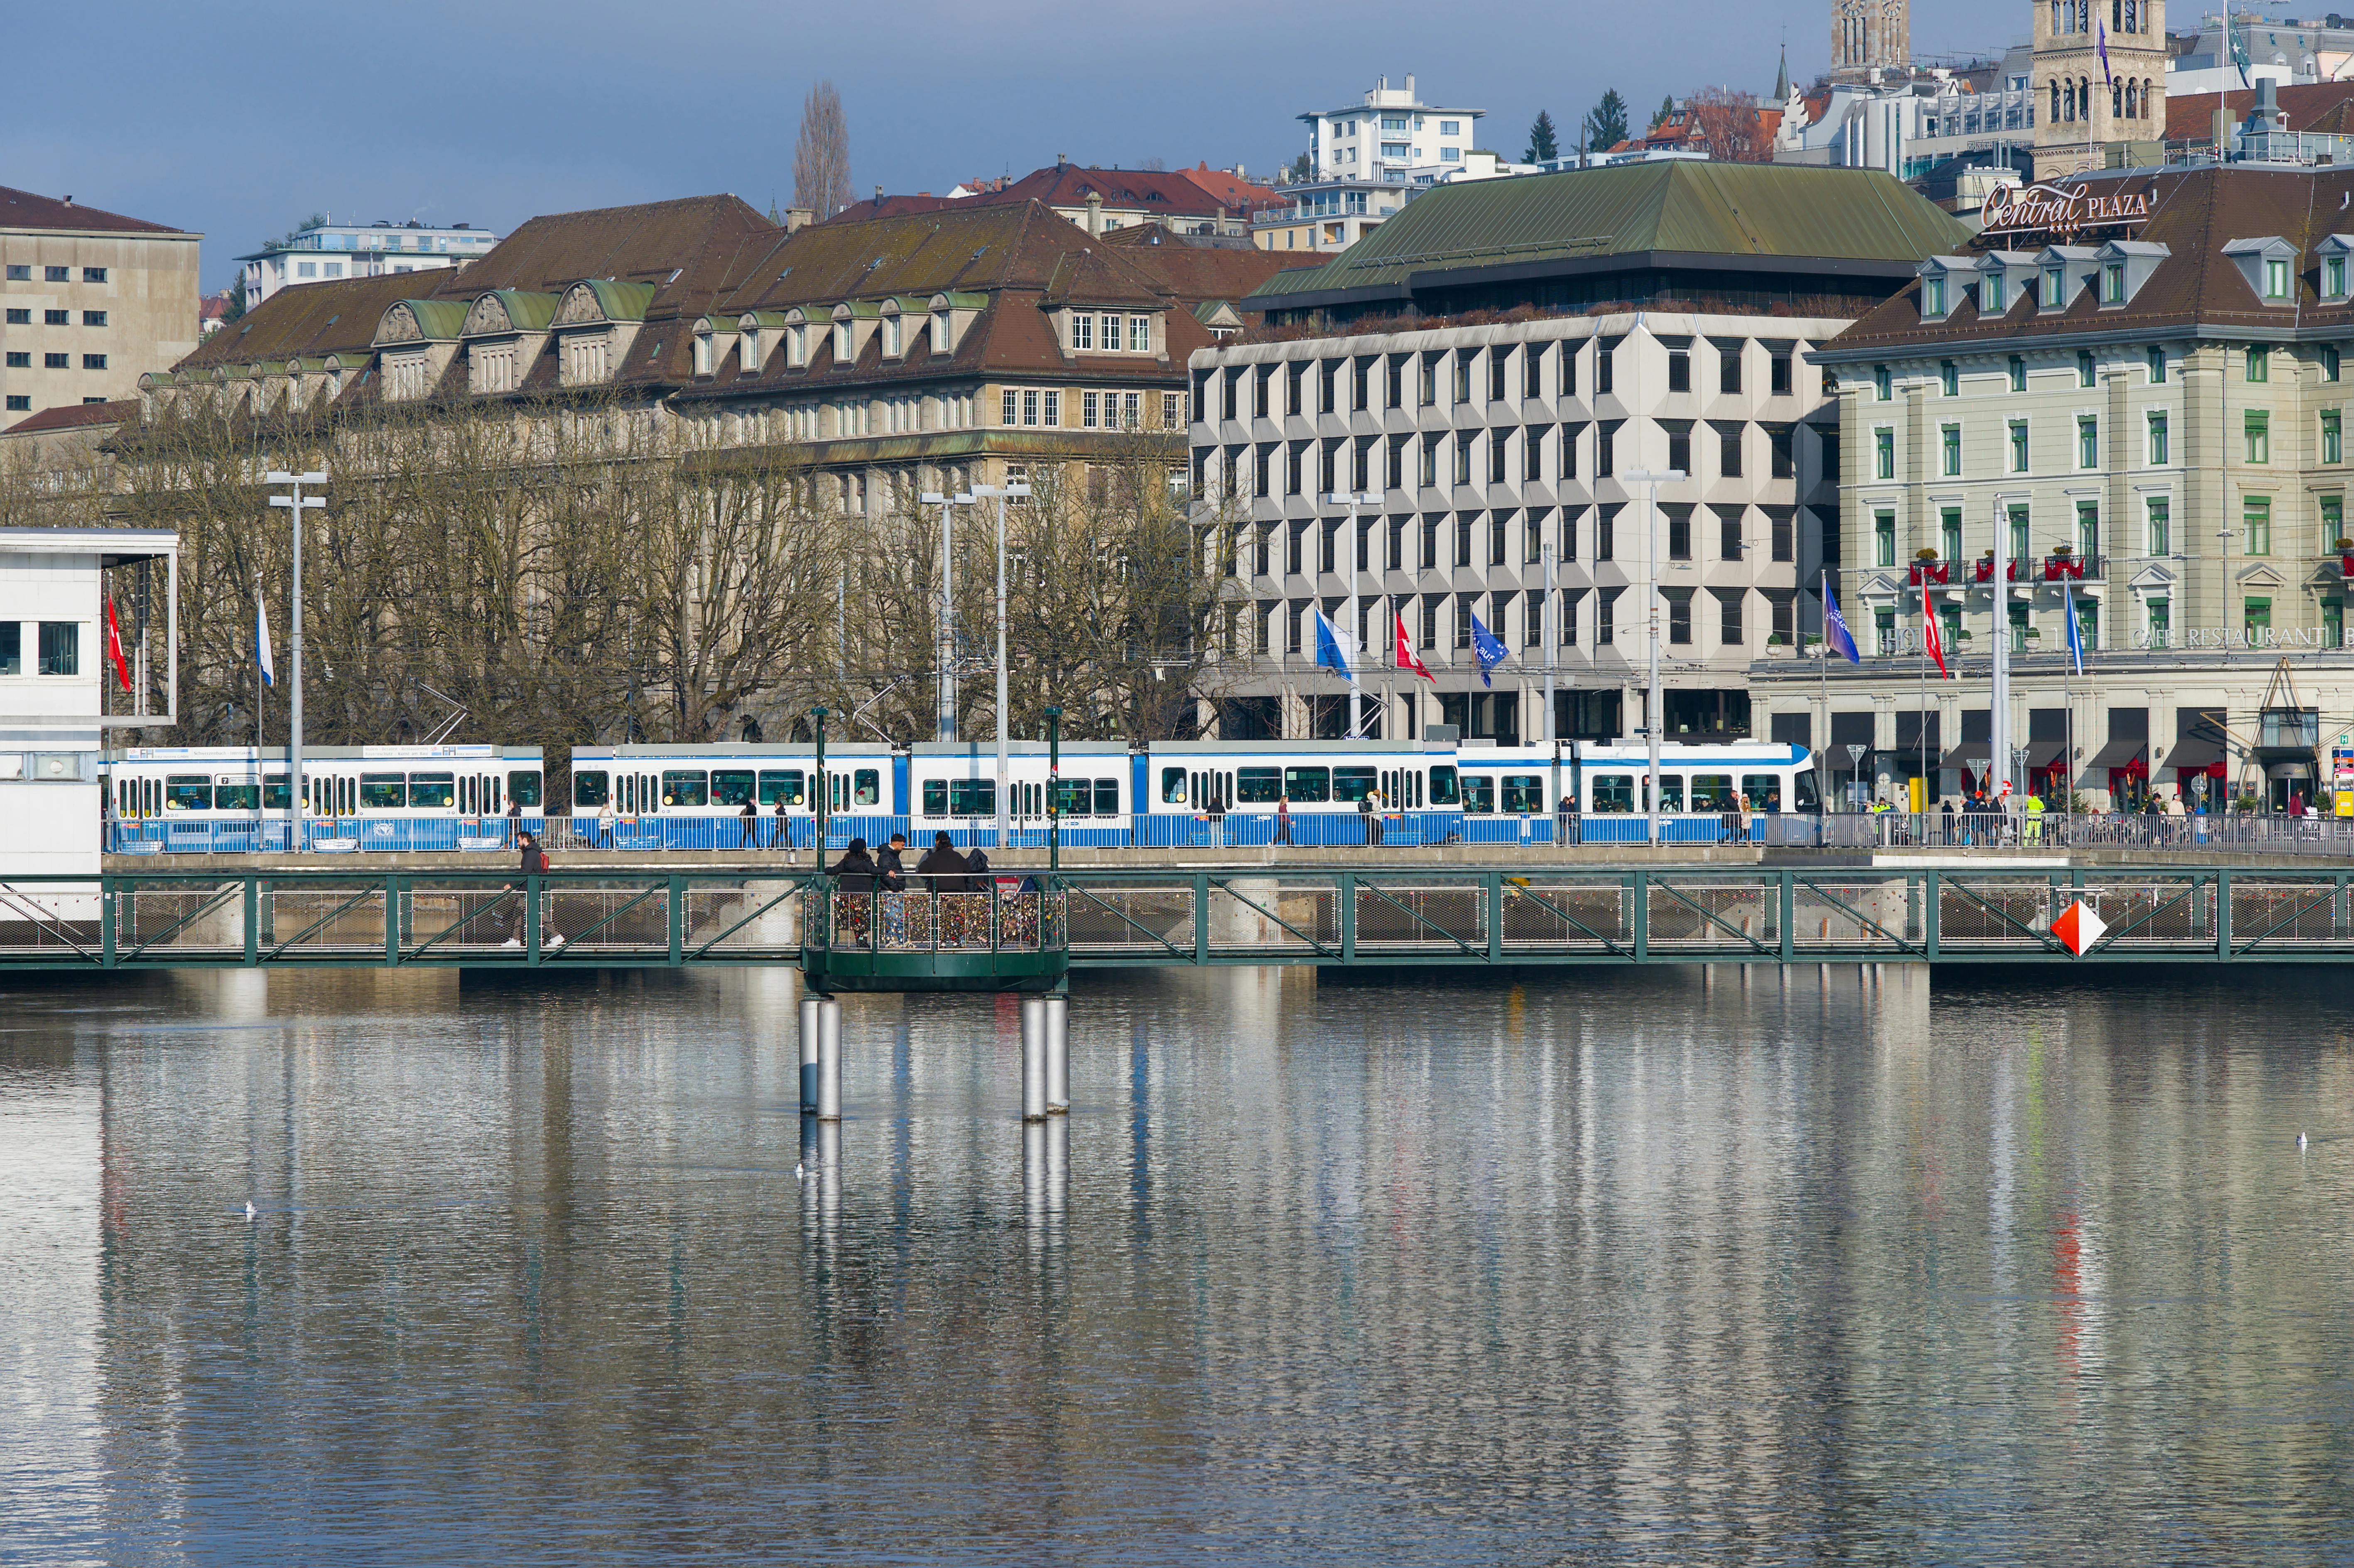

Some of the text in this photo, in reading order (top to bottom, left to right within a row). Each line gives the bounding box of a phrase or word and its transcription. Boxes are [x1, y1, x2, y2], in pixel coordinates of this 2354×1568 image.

[1981, 183, 2148, 228] Central PLAZA
[2189, 627, 2325, 646] RESTAURANT
[140, 749, 154, 758] FH
[443, 746, 456, 755] FH
